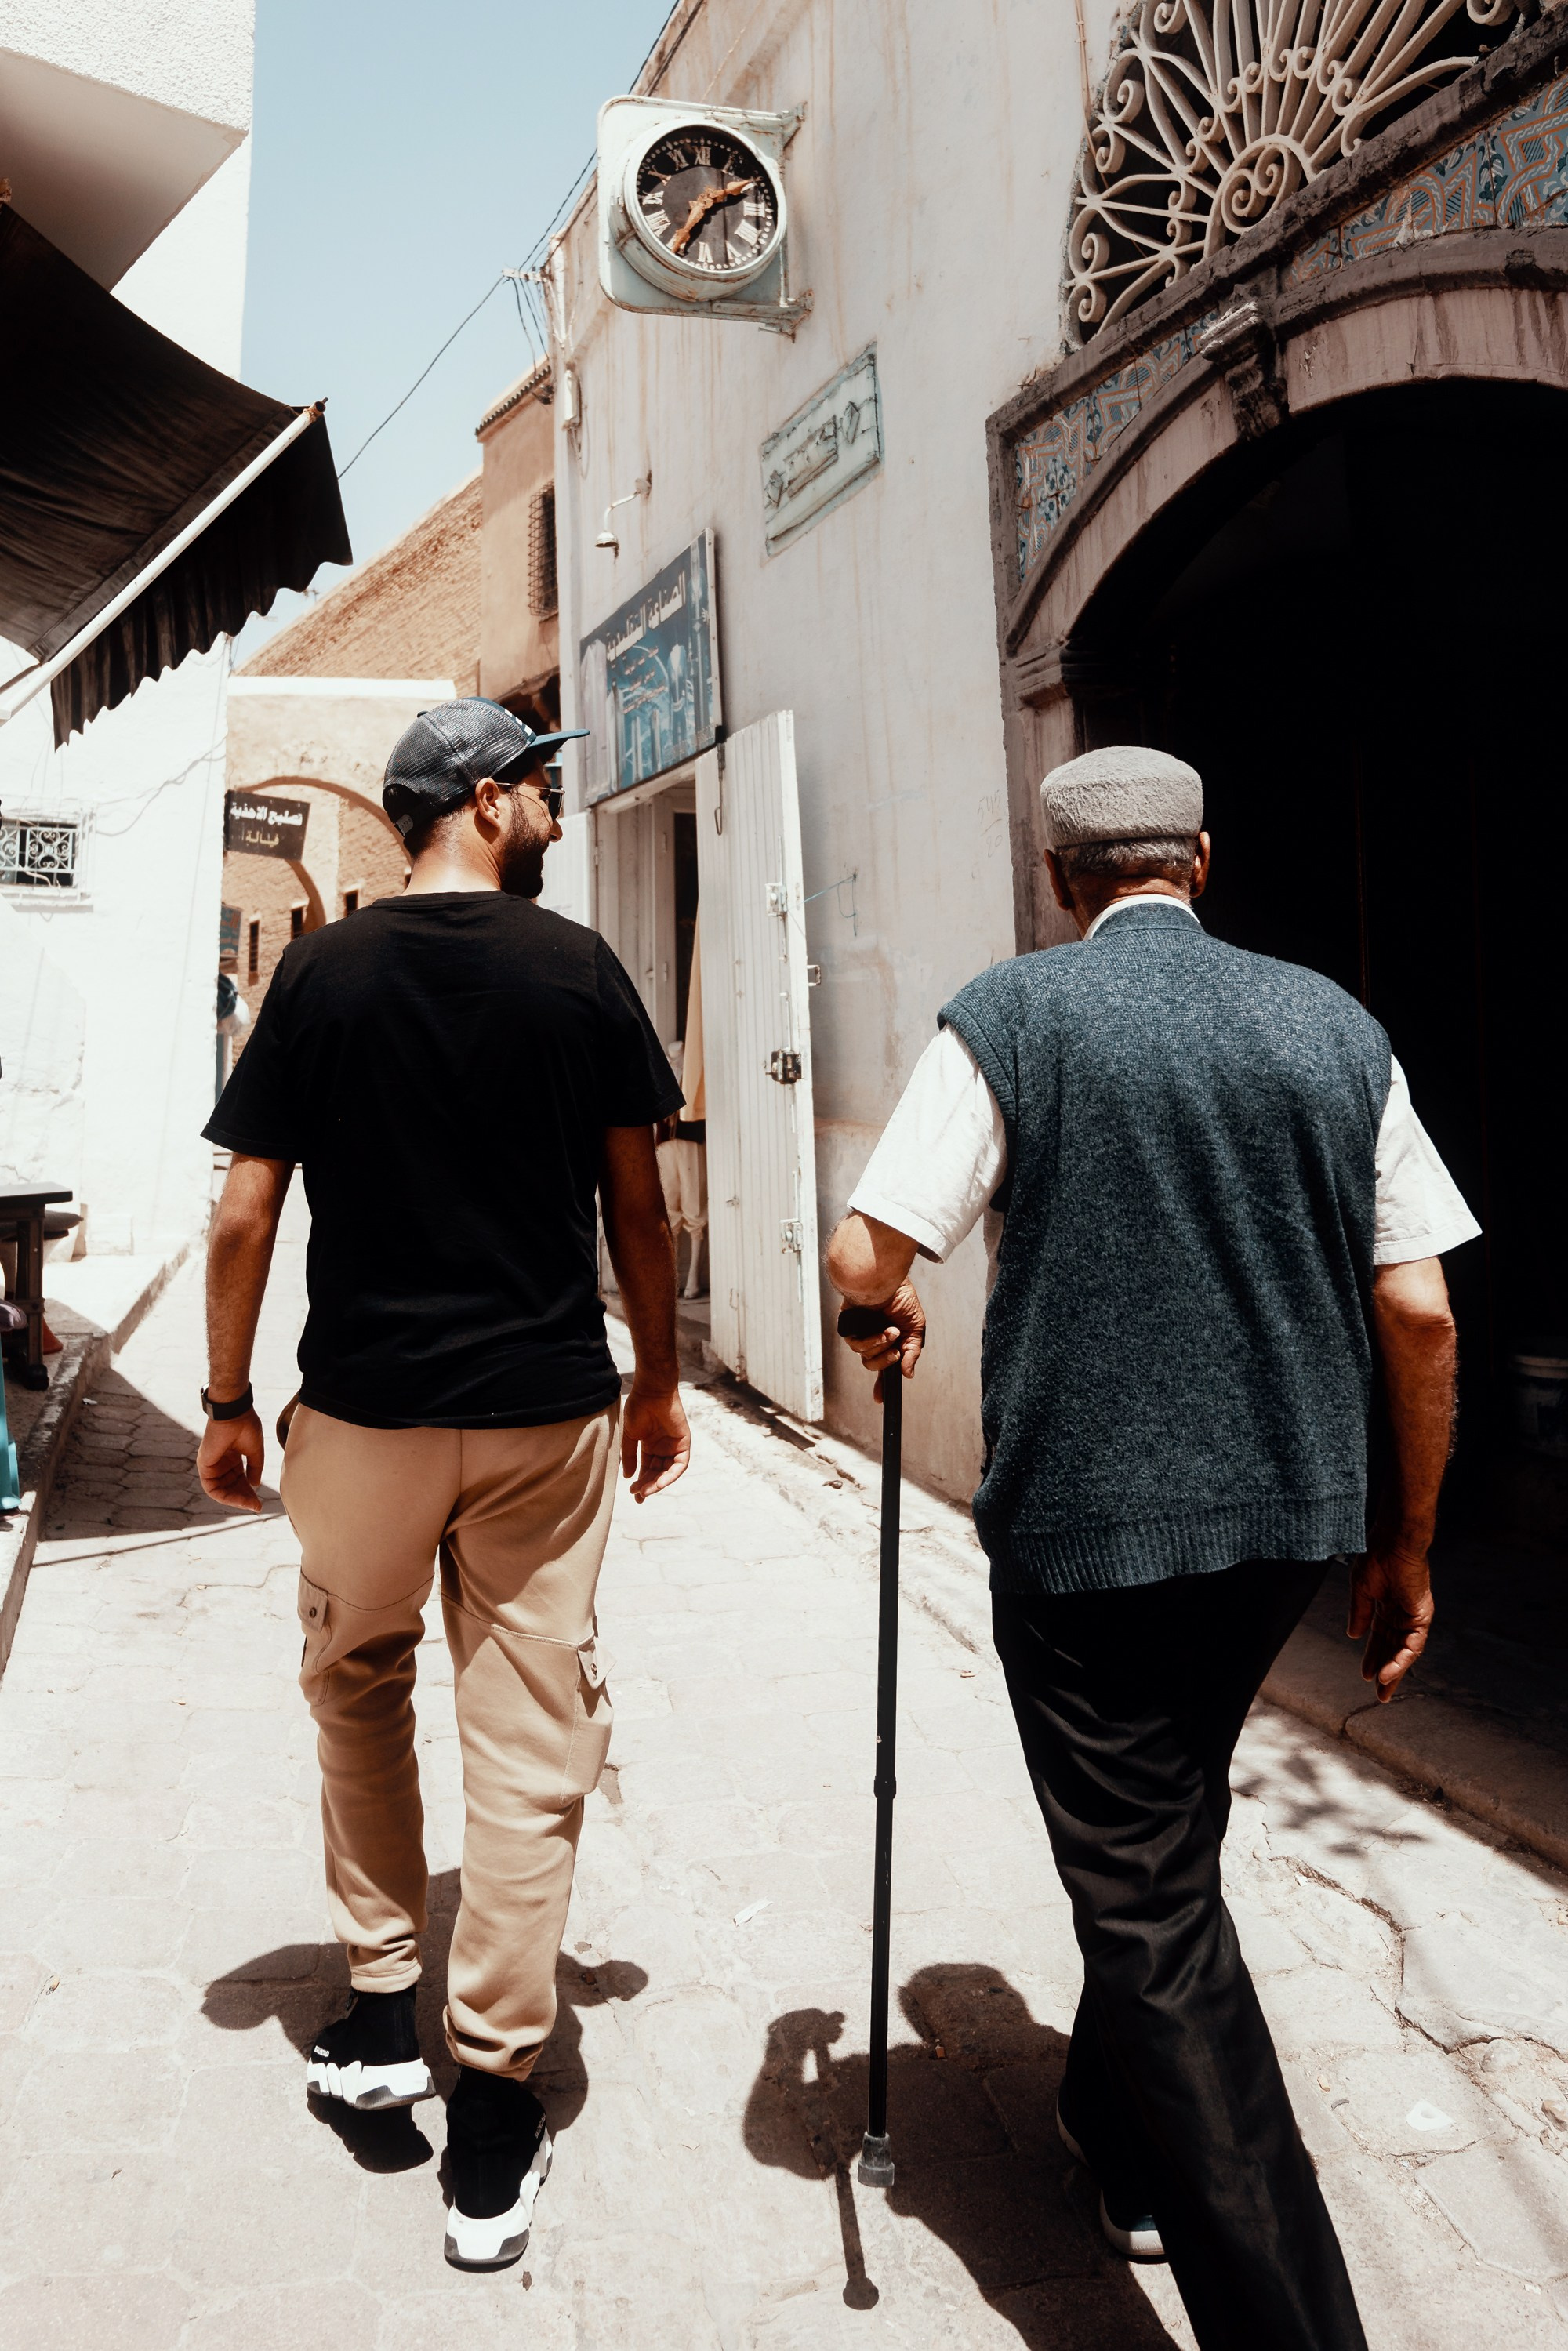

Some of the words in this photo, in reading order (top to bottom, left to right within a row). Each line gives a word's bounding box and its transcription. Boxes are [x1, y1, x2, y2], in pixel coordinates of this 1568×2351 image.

[648, 570, 686, 629] الصناعة
[607, 603, 646, 669] التقليدية
[267, 810, 303, 826] تصليح
